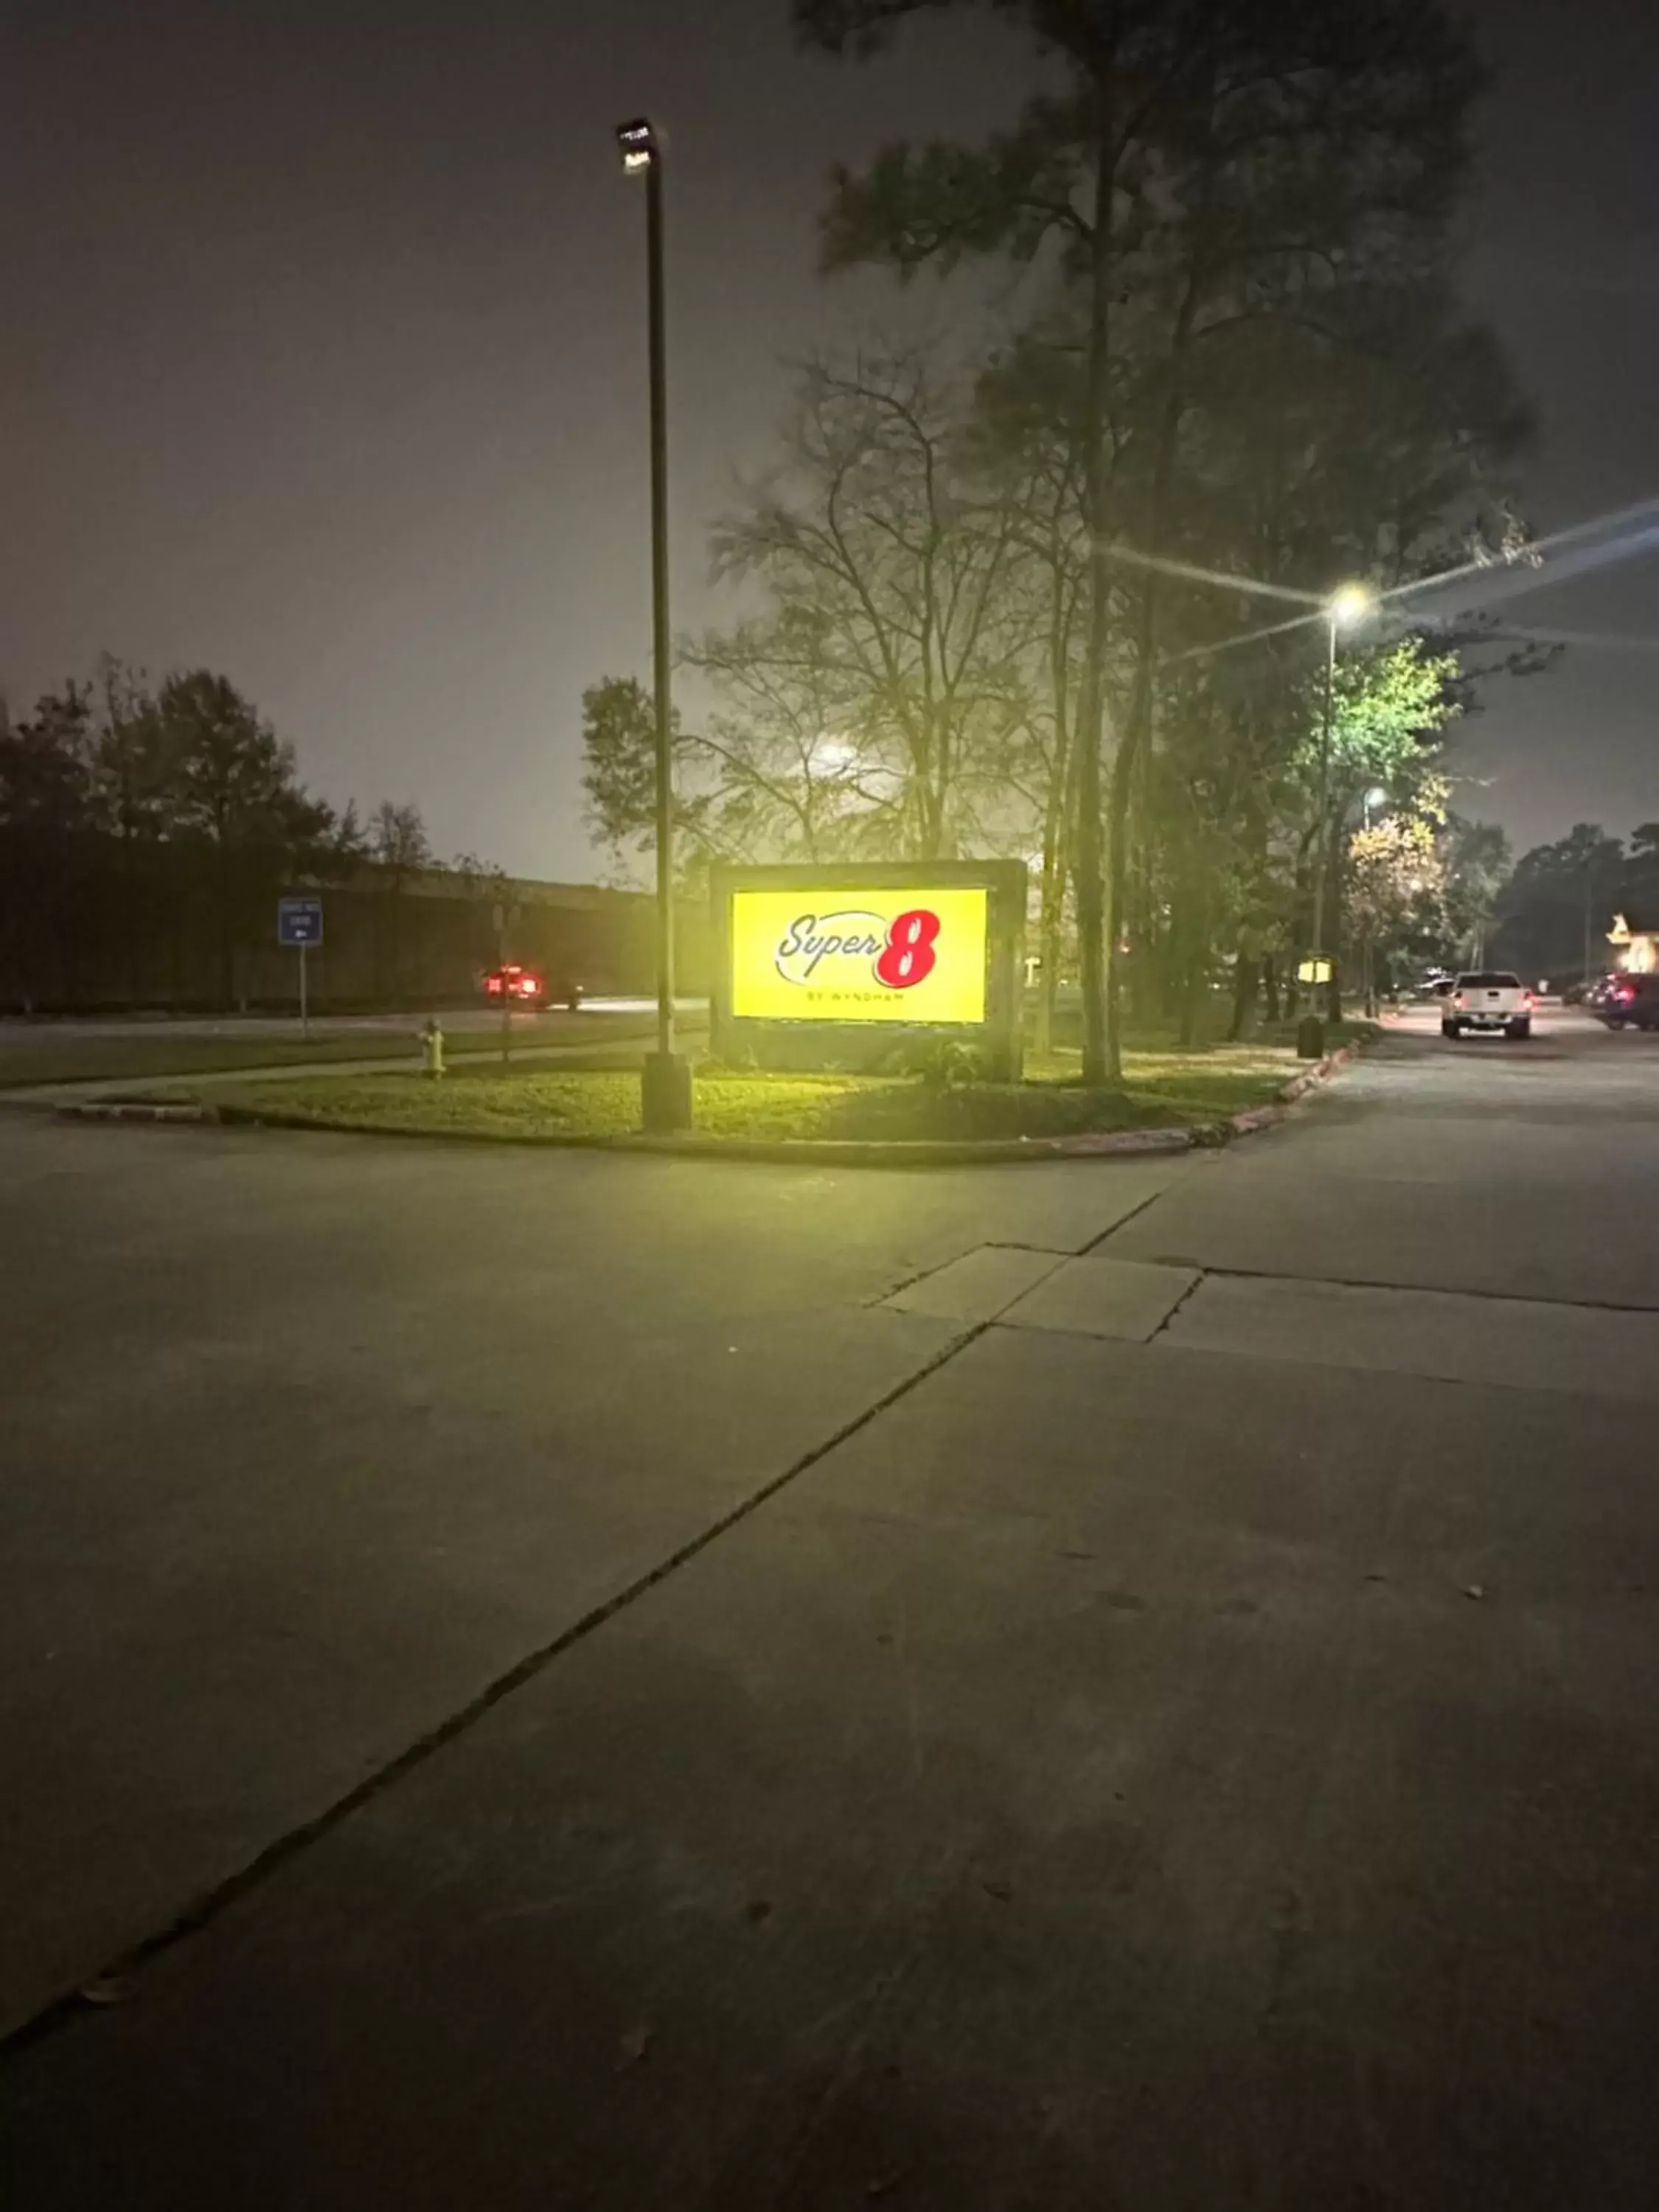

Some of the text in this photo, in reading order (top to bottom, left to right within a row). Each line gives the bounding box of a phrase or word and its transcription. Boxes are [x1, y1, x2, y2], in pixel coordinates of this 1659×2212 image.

[779, 909, 941, 989] Super 8
[806, 991, 905, 1002] BY WYNDHAM
